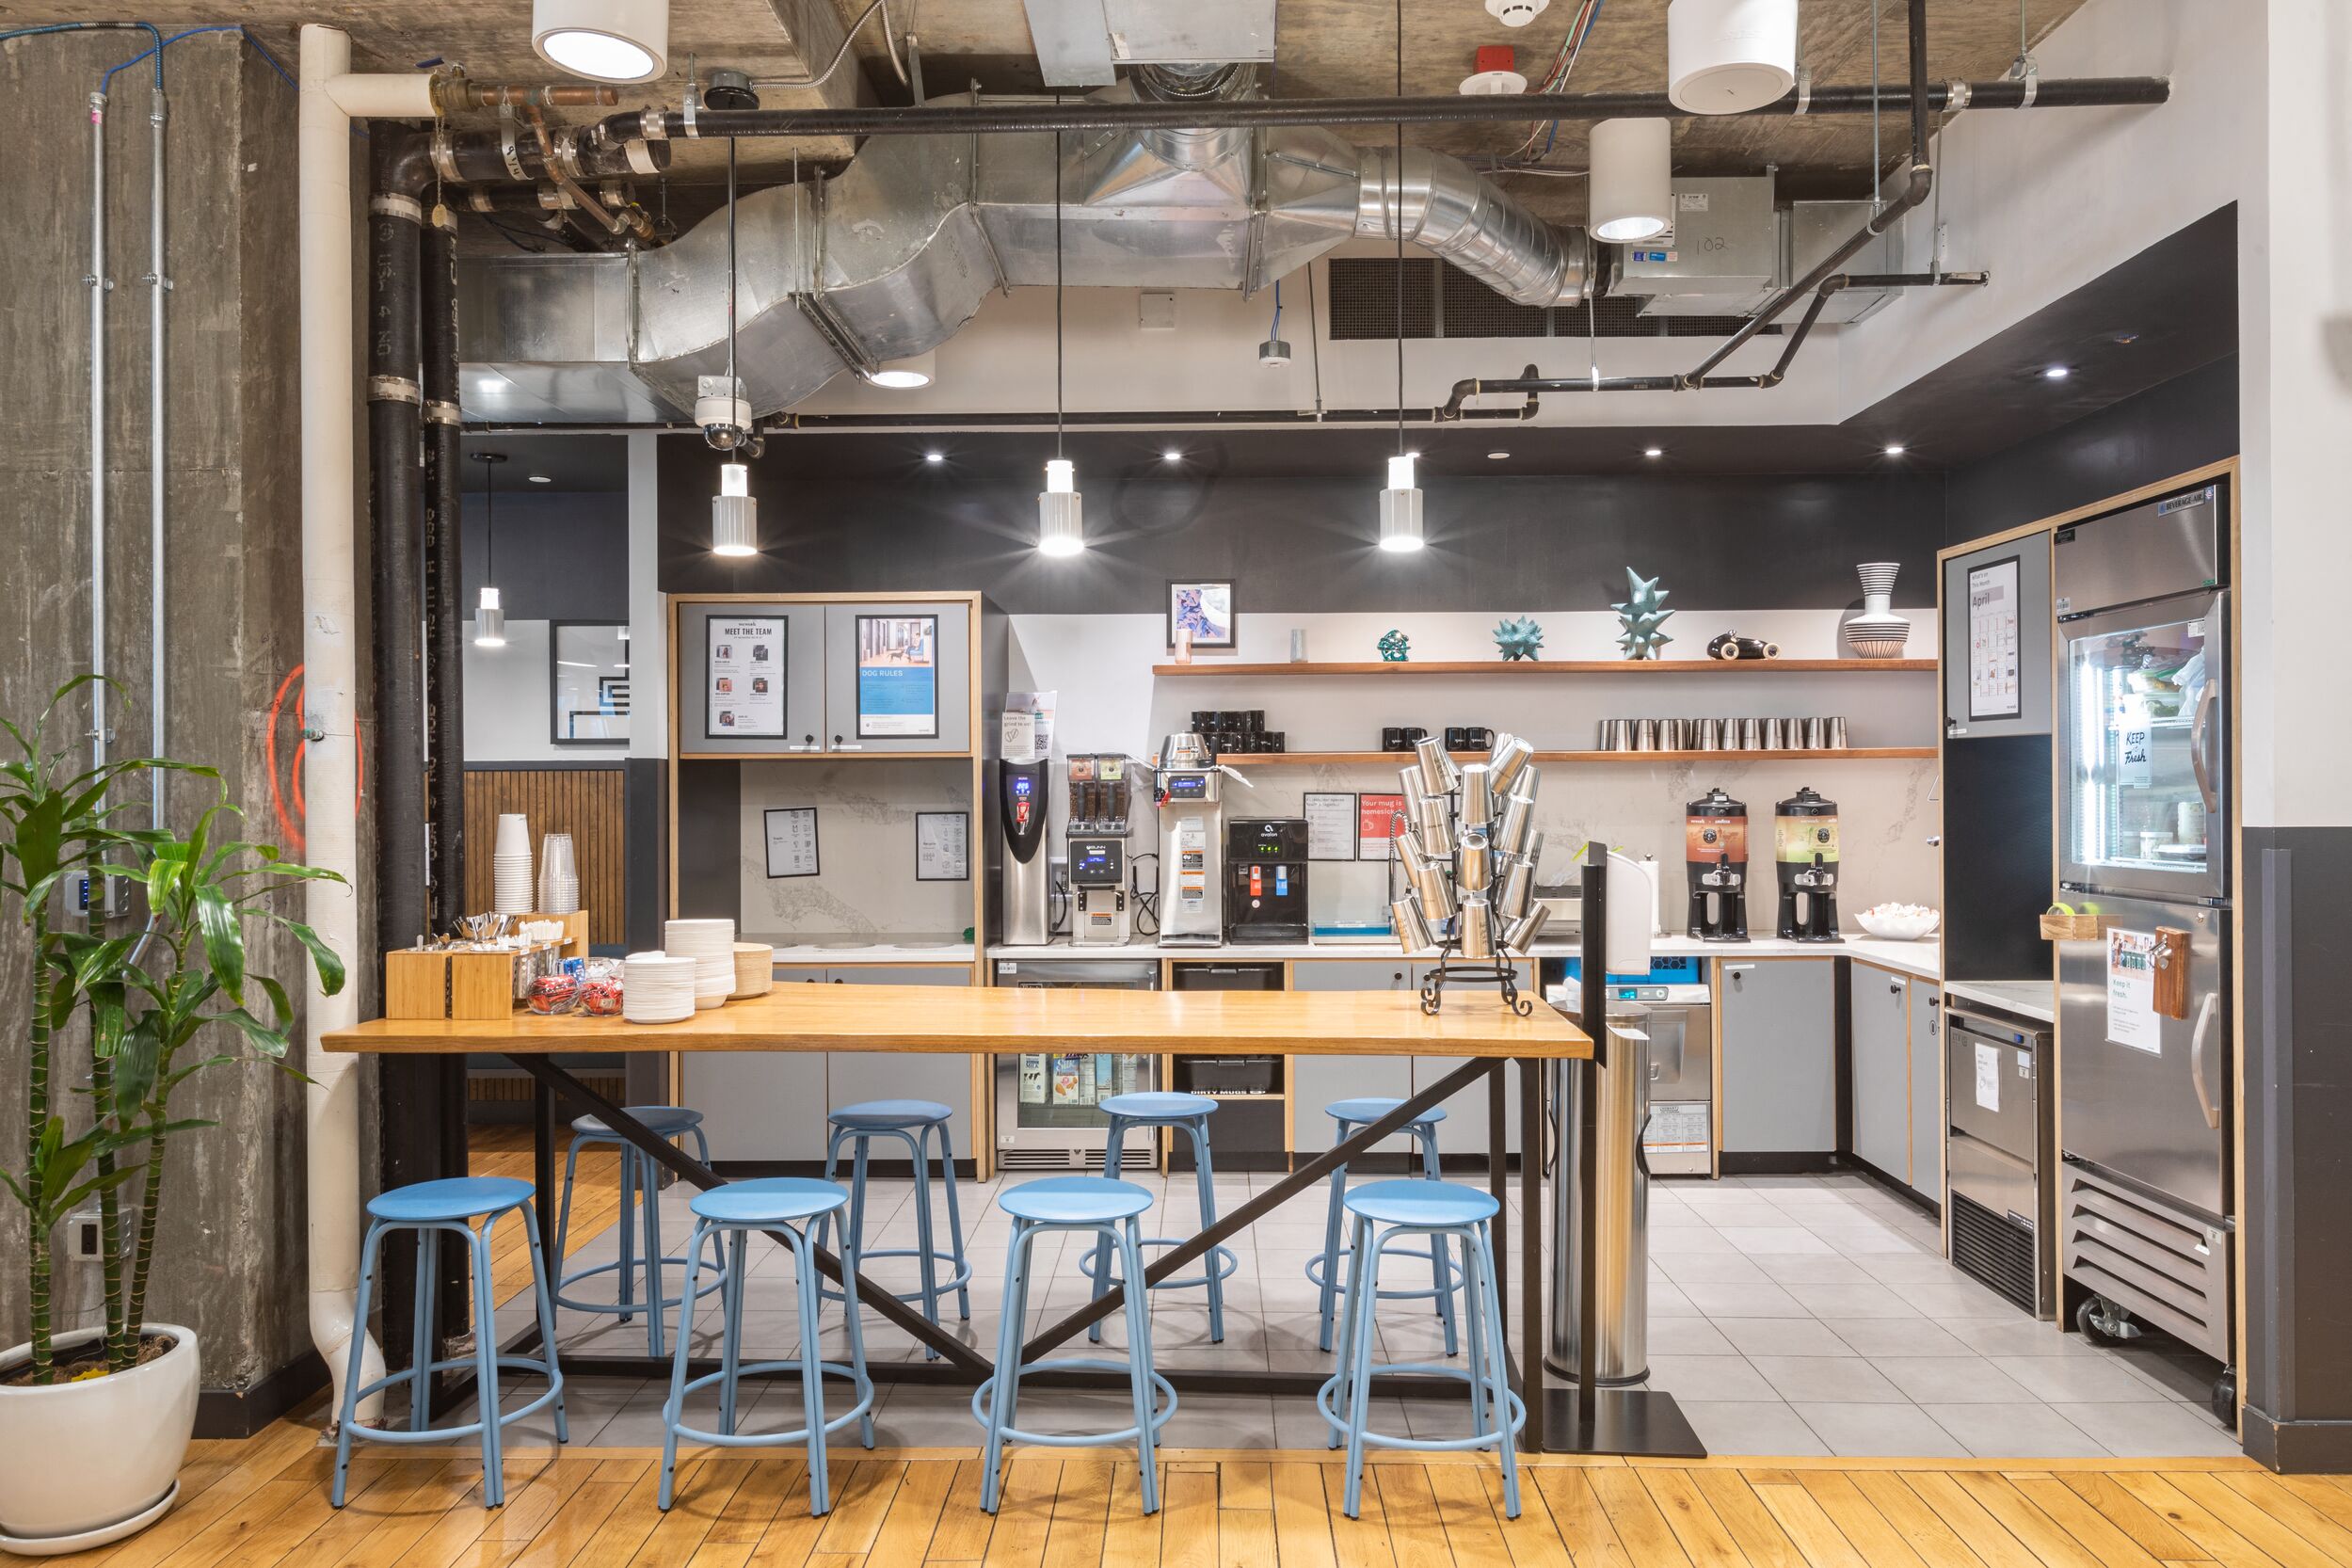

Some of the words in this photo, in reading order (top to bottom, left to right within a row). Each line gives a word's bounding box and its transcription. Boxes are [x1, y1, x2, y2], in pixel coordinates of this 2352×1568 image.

[1697, 236, 1729, 256] 102
[1972, 592, 1990, 610] April
[2126, 731, 2145, 745] KEEP
[2124, 748, 2147, 764] Fresh
[2113, 979, 2125, 988] Keep
